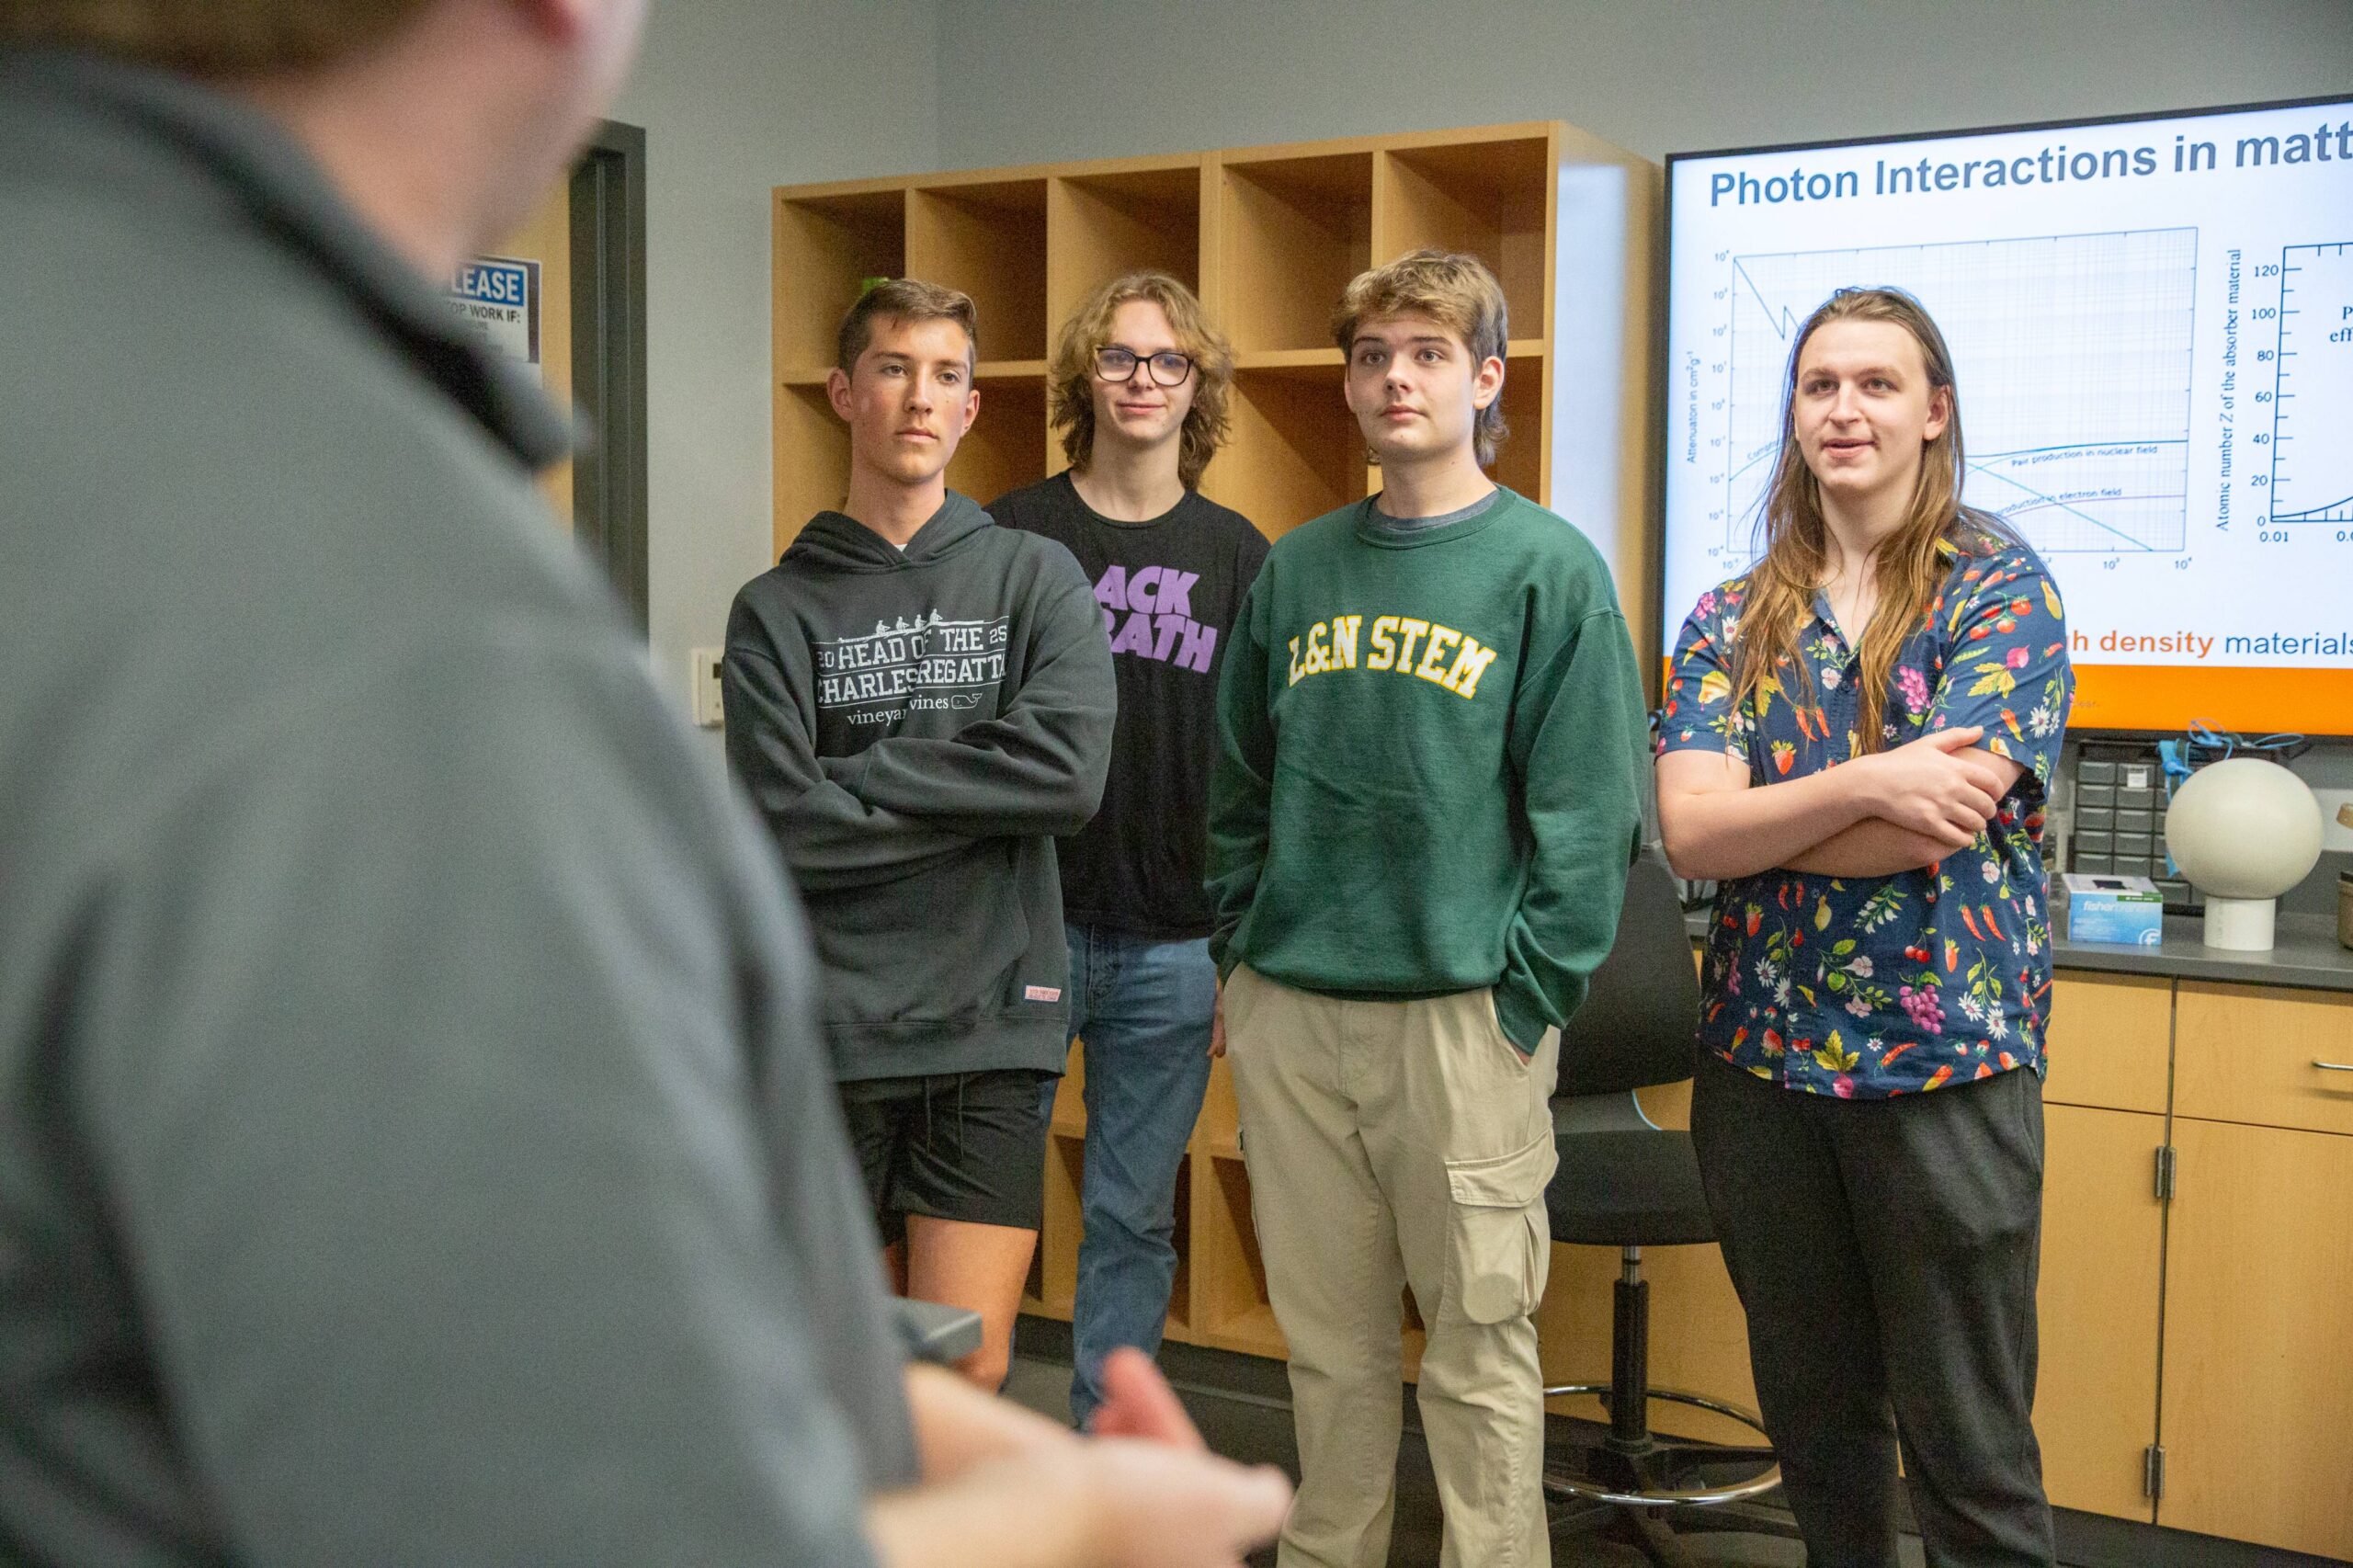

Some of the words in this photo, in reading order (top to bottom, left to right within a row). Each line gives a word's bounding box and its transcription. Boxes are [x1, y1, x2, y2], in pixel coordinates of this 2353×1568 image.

[1711, 167, 1858, 207] Photon
[1876, 145, 2156, 195] Interactions
[2175, 135, 2216, 172] in
[2235, 120, 2353, 167] matt
[2226, 249, 2241, 303] material
[2255, 265, 2279, 277] 120
[469, 304, 504, 322] WORK
[506, 310, 520, 324] IF:
[2252, 308, 2277, 320] 100
[2222, 309, 2237, 367] absorber
[2257, 350, 2274, 361] 80
[2221, 371, 2235, 391] the
[1688, 391, 1698, 401] in
[2221, 394, 2234, 409] of
[2256, 392, 2272, 403] 60
[2220, 413, 2234, 423] Z
[2253, 433, 2269, 445] 40
[2032, 451, 2082, 464] production
[2086, 449, 2095, 457] in
[2097, 447, 2132, 456] nuclear
[2136, 445, 2158, 454] field
[2219, 426, 2233, 477] number
[2251, 475, 2268, 486] 20
[2059, 490, 2098, 500] electron
[2101, 488, 2122, 496] field
[2215, 483, 2230, 531] Atomic
[2257, 516, 2266, 527] 0
[2259, 531, 2289, 542] 0.01
[838, 637, 905, 670] HEAD
[939, 628, 984, 653] THE
[989, 625, 1007, 644] 25
[2099, 631, 2214, 659] density
[1289, 615, 1362, 687] L&N
[1367, 615, 1497, 699] STEM
[909, 694, 949, 710] vines
